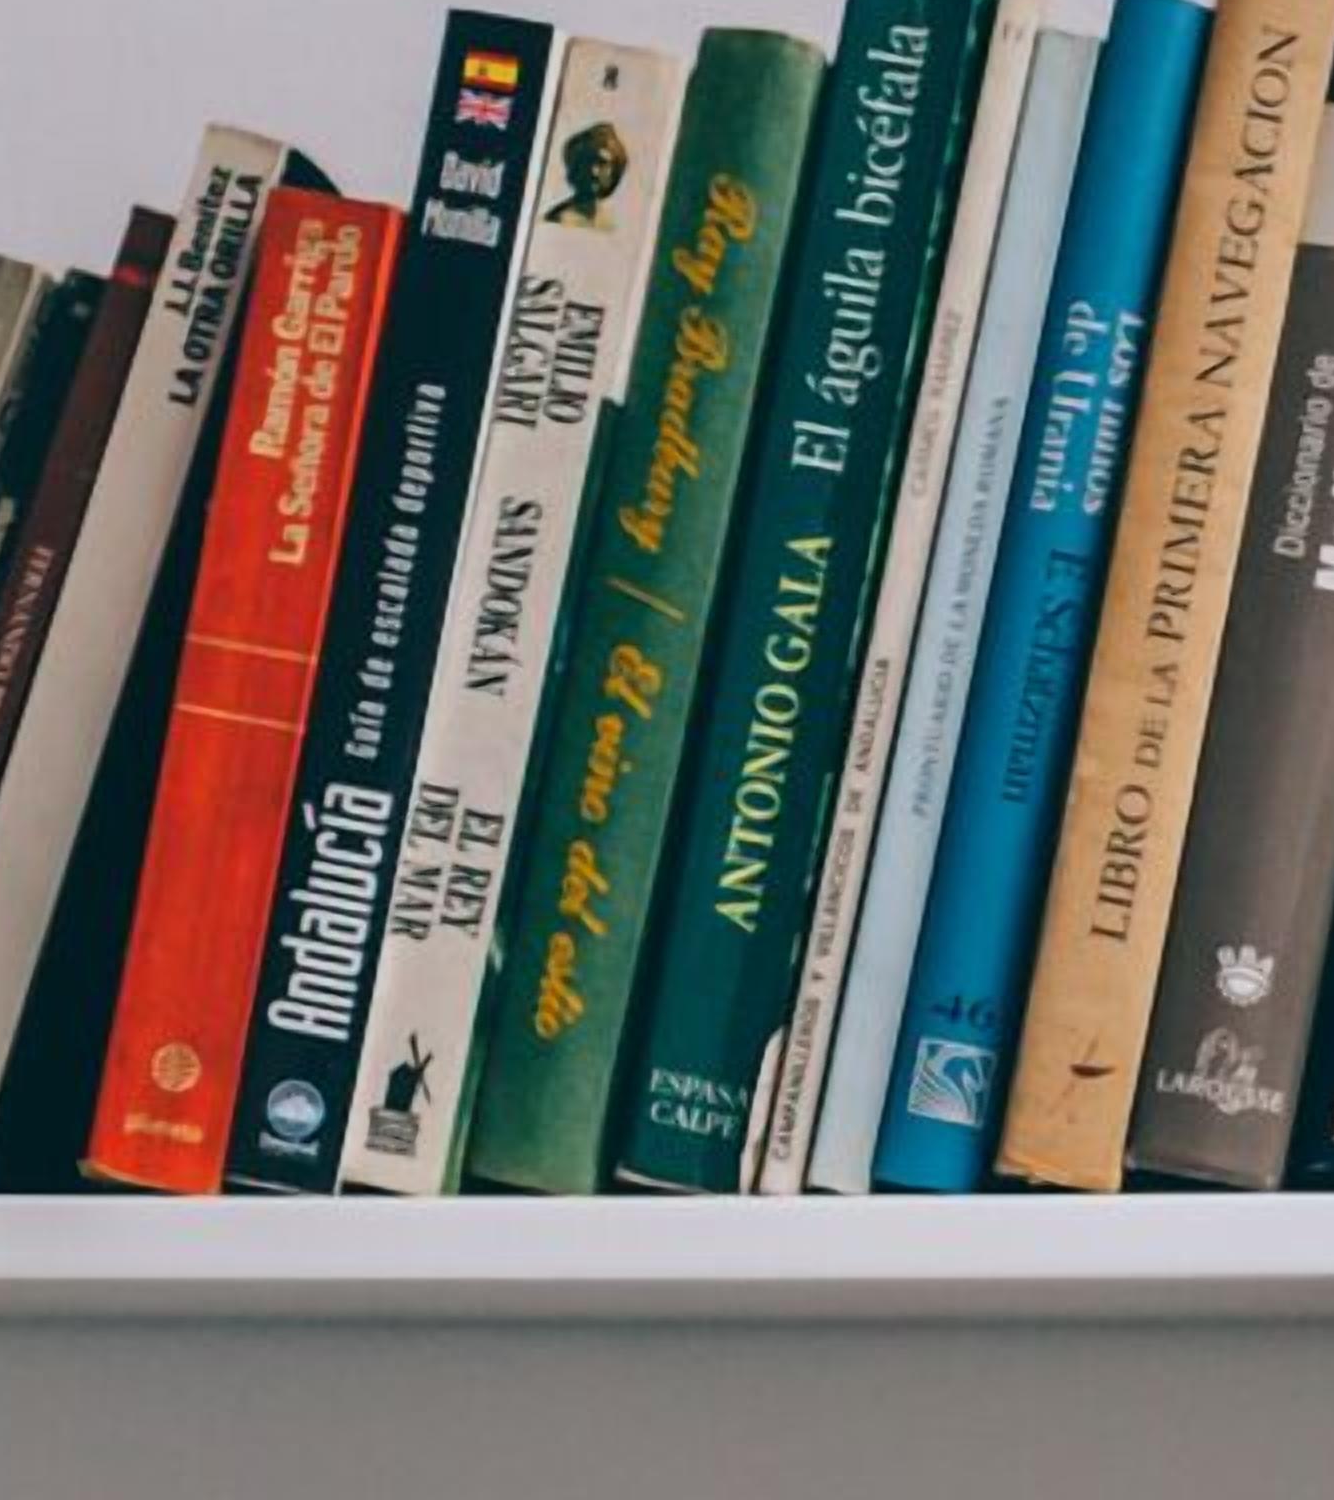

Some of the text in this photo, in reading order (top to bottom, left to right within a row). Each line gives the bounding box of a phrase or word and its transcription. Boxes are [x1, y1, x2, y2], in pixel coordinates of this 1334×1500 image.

[170, 167, 266, 407] LA OTRA ORILLA
[249, 221, 330, 458] Ramón Garriga
[492, 269, 567, 428] SALGARI
[791, 25, 929, 472] El águila bicéfala
[269, 226, 360, 564] La Señora de El Pardo
[393, 384, 446, 513] deportiva
[544, 301, 605, 424] EMILIO
[1032, 297, 1110, 511] de Urania
[553, 176, 770, 938] Ray Bradbury El vino del
[1090, 27, 1298, 941] LIBRO DE LA PRIMERA NAVEGACION
[1273, 397, 1333, 558] Diccionario
[359, 658, 394, 689] de
[372, 524, 419, 647] escalada
[715, 537, 832, 932] ANTONIO GALA
[268, 783, 393, 1040] Andalucía
[377, 780, 464, 940] DEL MAR
[440, 808, 504, 936] EL REY
